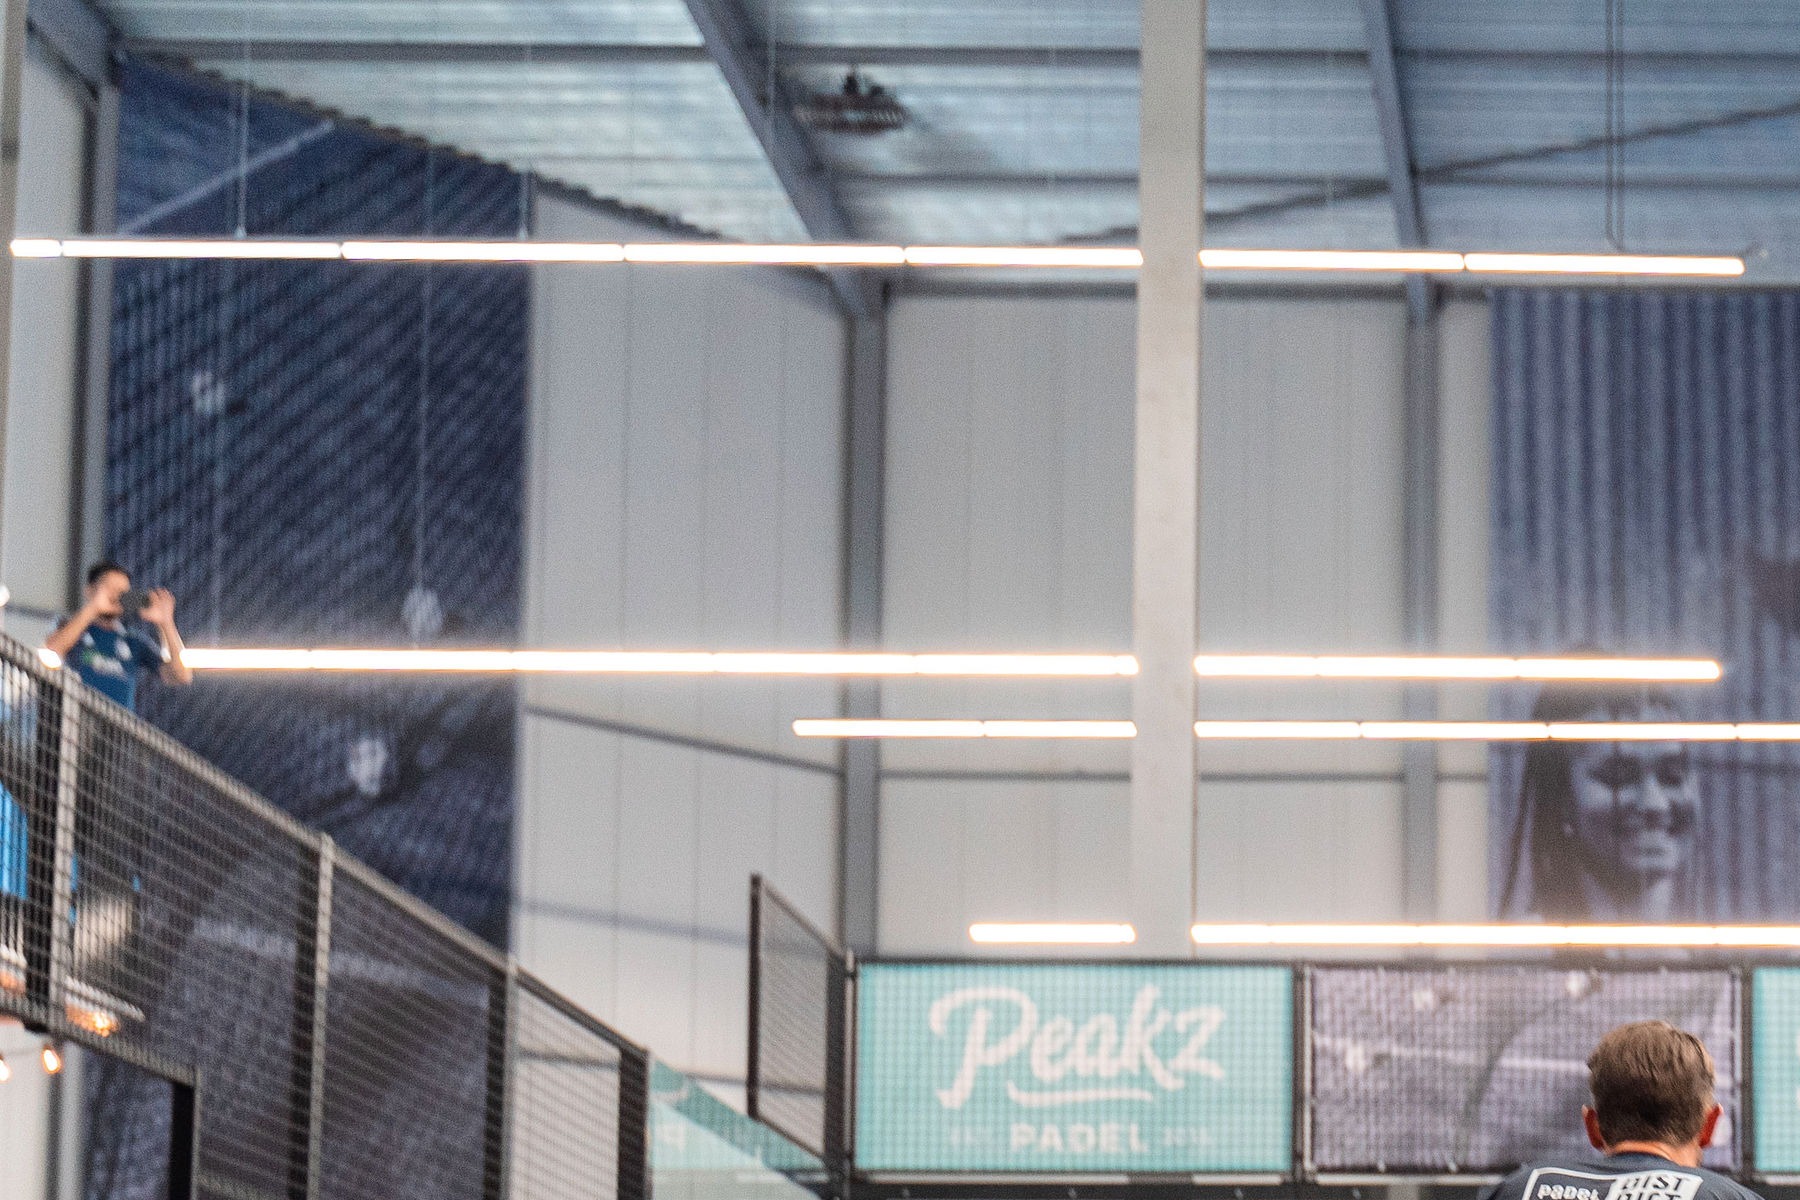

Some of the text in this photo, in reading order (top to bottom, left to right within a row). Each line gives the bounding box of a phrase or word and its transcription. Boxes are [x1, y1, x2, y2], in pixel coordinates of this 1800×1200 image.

[929, 984, 1227, 1110] Peakz
[1010, 1122, 1150, 1154] PADEL
[1620, 1174, 1690, 1192] DIST
